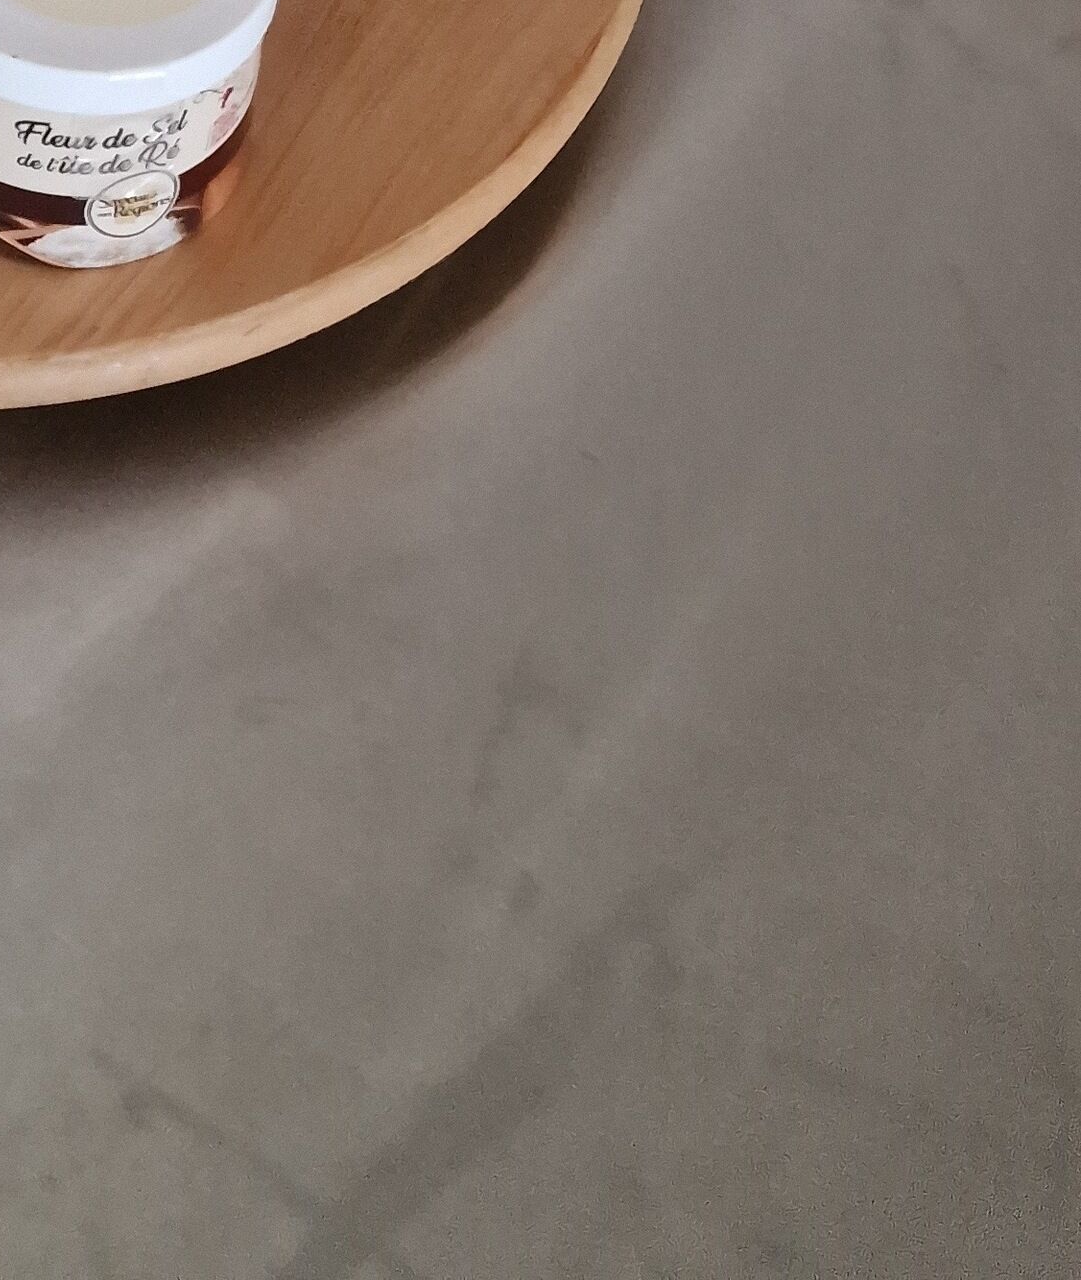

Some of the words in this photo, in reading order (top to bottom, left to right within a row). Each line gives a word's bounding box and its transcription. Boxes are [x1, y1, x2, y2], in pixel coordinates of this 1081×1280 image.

[14, 119, 97, 150] Fleur
[101, 127, 138, 150] de
[141, 108, 189, 146] Sel
[16, 152, 43, 171] de
[98, 153, 133, 175] de
[137, 137, 182, 170] Ré
